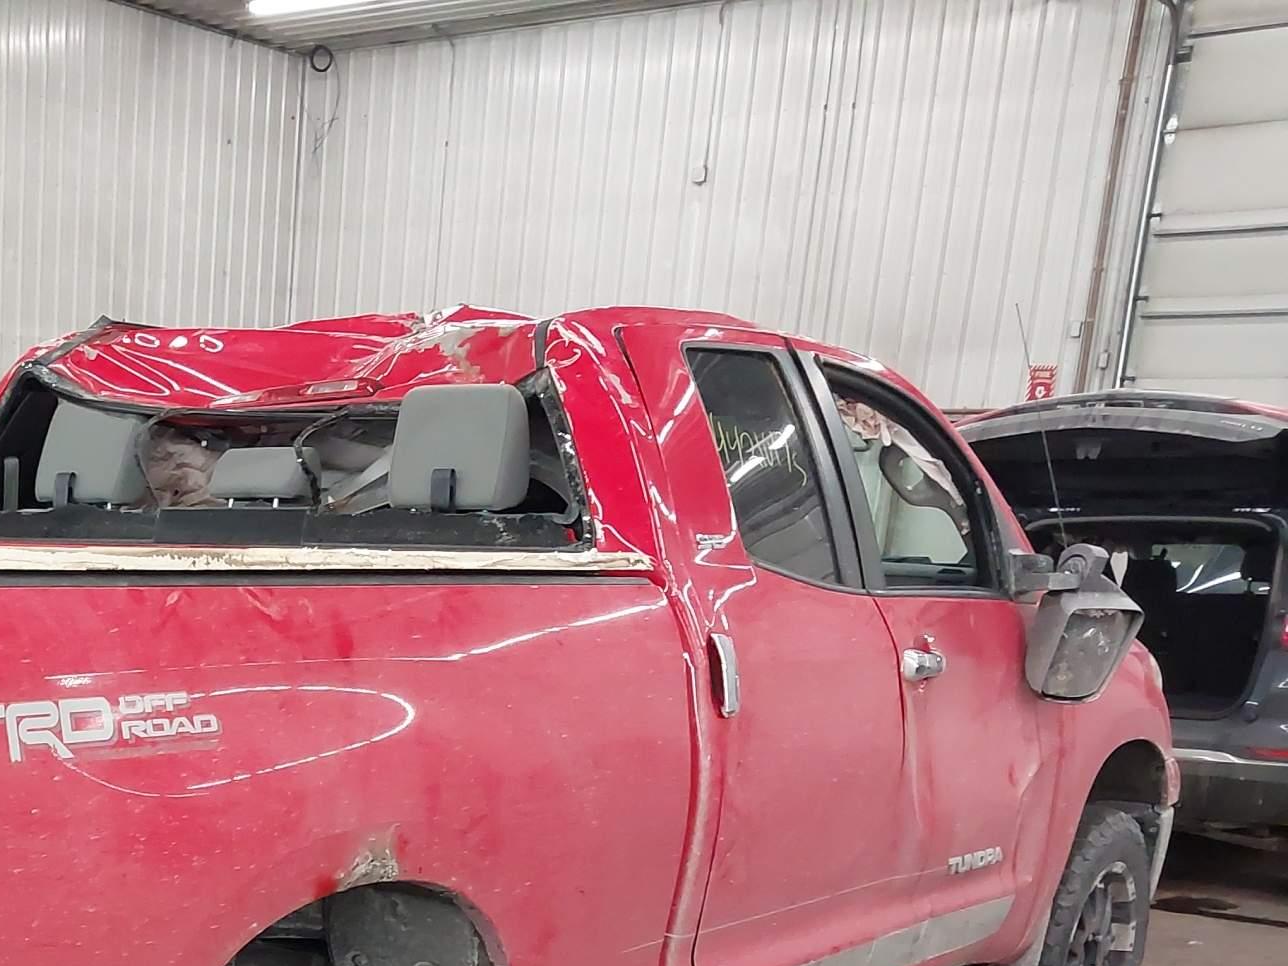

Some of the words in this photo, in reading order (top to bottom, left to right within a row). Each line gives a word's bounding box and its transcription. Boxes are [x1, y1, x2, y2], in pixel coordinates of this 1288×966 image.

[118, 691, 189, 714] OFF
[120, 714, 219, 739] ROAD
[948, 846, 1004, 875] TUNDRA
